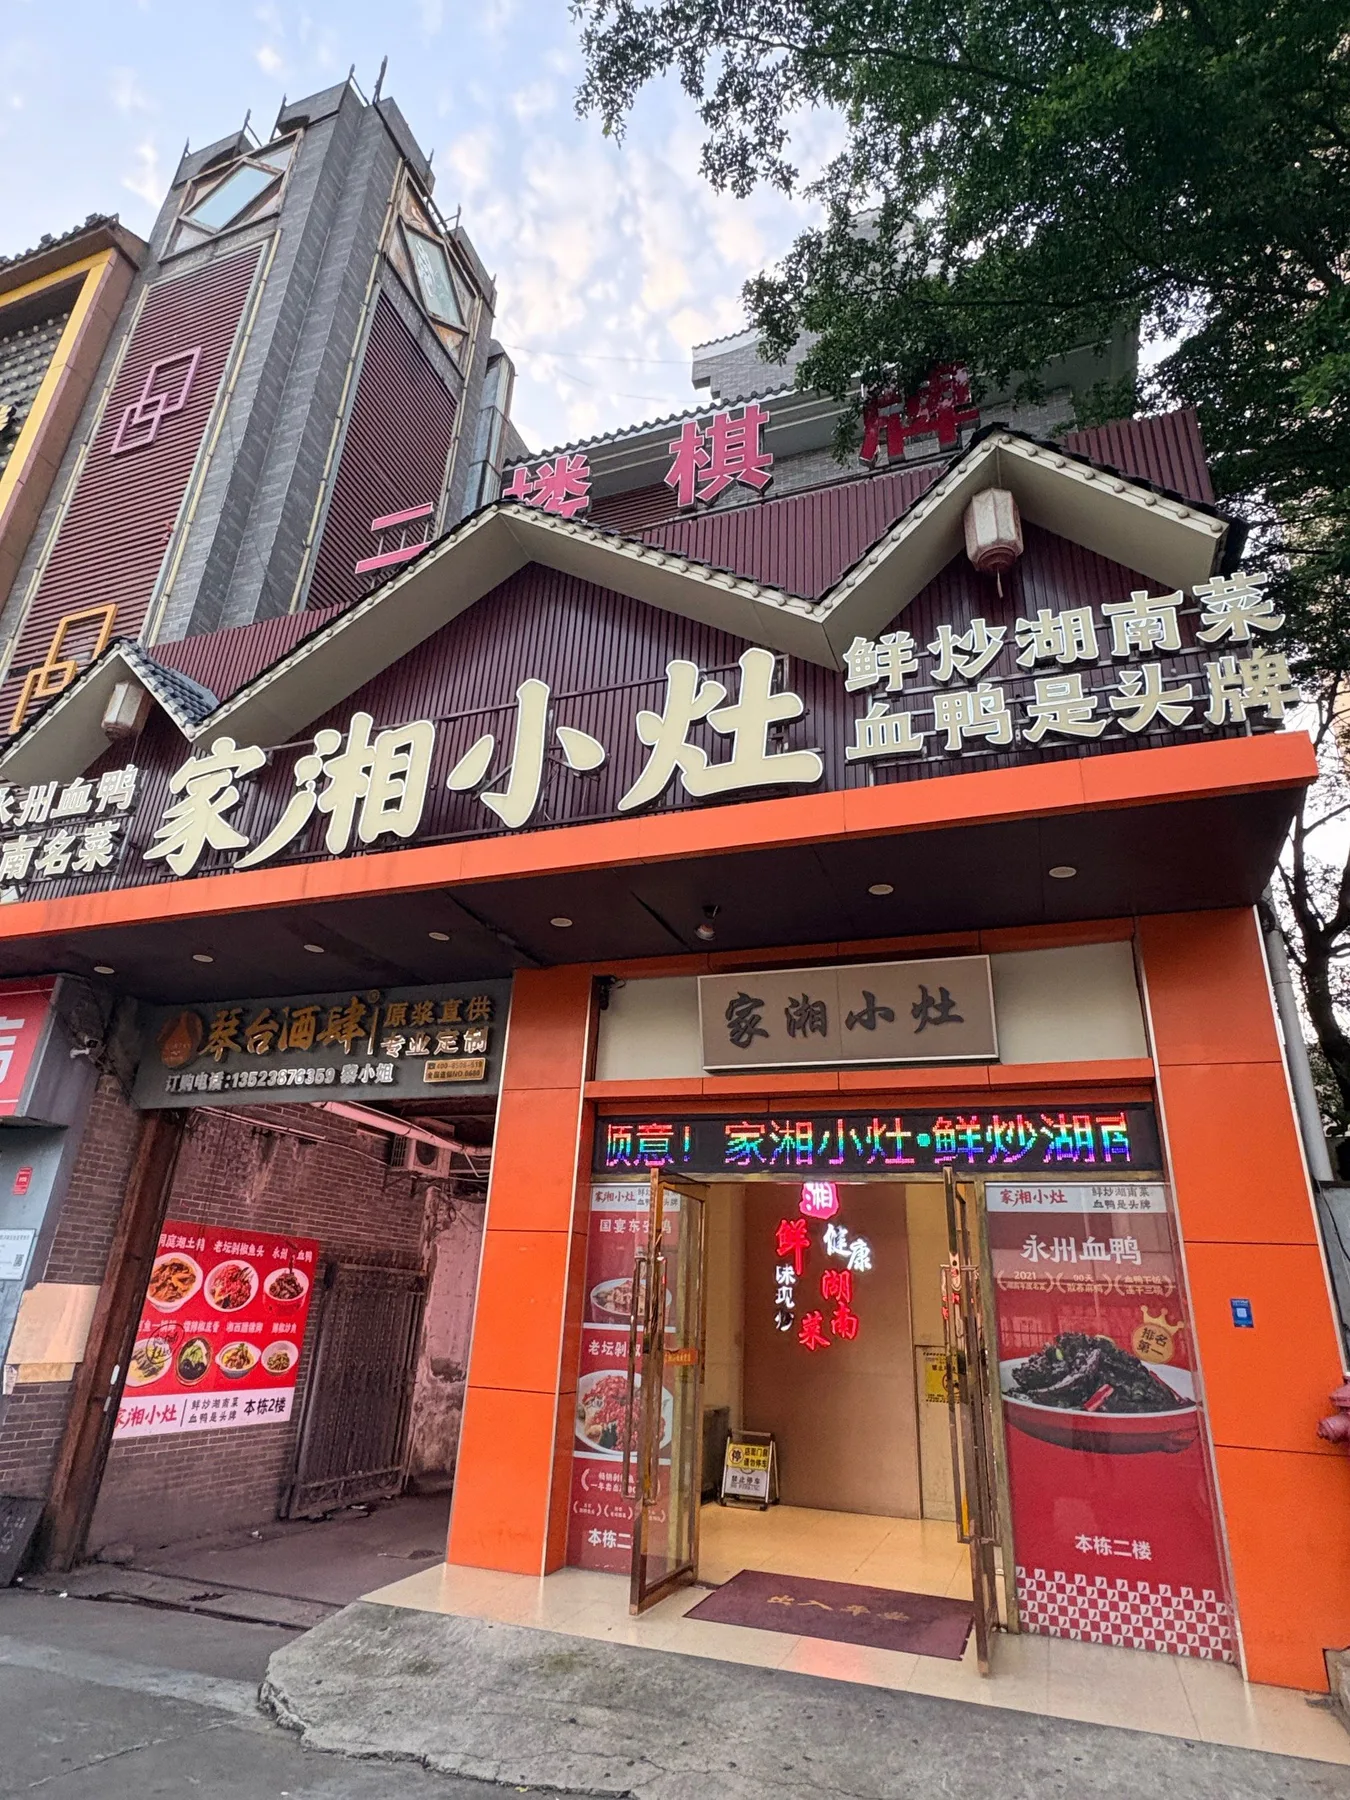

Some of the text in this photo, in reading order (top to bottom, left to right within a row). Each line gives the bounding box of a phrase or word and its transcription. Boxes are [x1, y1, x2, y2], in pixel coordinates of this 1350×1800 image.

[843, 570, 1286, 693] 鲜炒湖南菜
[845, 648, 1300, 760] 血鸭是头牌
[143, 648, 824, 877] 家湘小灶
[383, 995, 492, 1028] 原浆直供
[724, 984, 965, 1048] 家湘小灶
[199, 995, 368, 1062] 琴台酒肆
[380, 1025, 489, 1058] 专业定制
[595, 1191, 636, 1203] 家湘小灶
[1000, 1189, 1067, 1207] 家湘小灶
[1091, 1186, 1150, 1197] 鲜炒湖南菜
[1092, 1200, 1151, 1210] 血鸭是头牌
[1020, 1235, 1142, 1265] 永州血鸭
[1014, 1271, 1037, 1281] 2021
[1136, 1339, 1164, 1356] 第一
[1141, 1327, 1168, 1347] 排名
[191, 1397, 239, 1411] 鲜炒湖南菜
[244, 1396, 286, 1417] 本栋2楼
[188, 1410, 237, 1424] 血鸭是头牌
[588, 1528, 632, 1549] 本栋二
[1074, 1534, 1152, 1561] 本栋二楼
